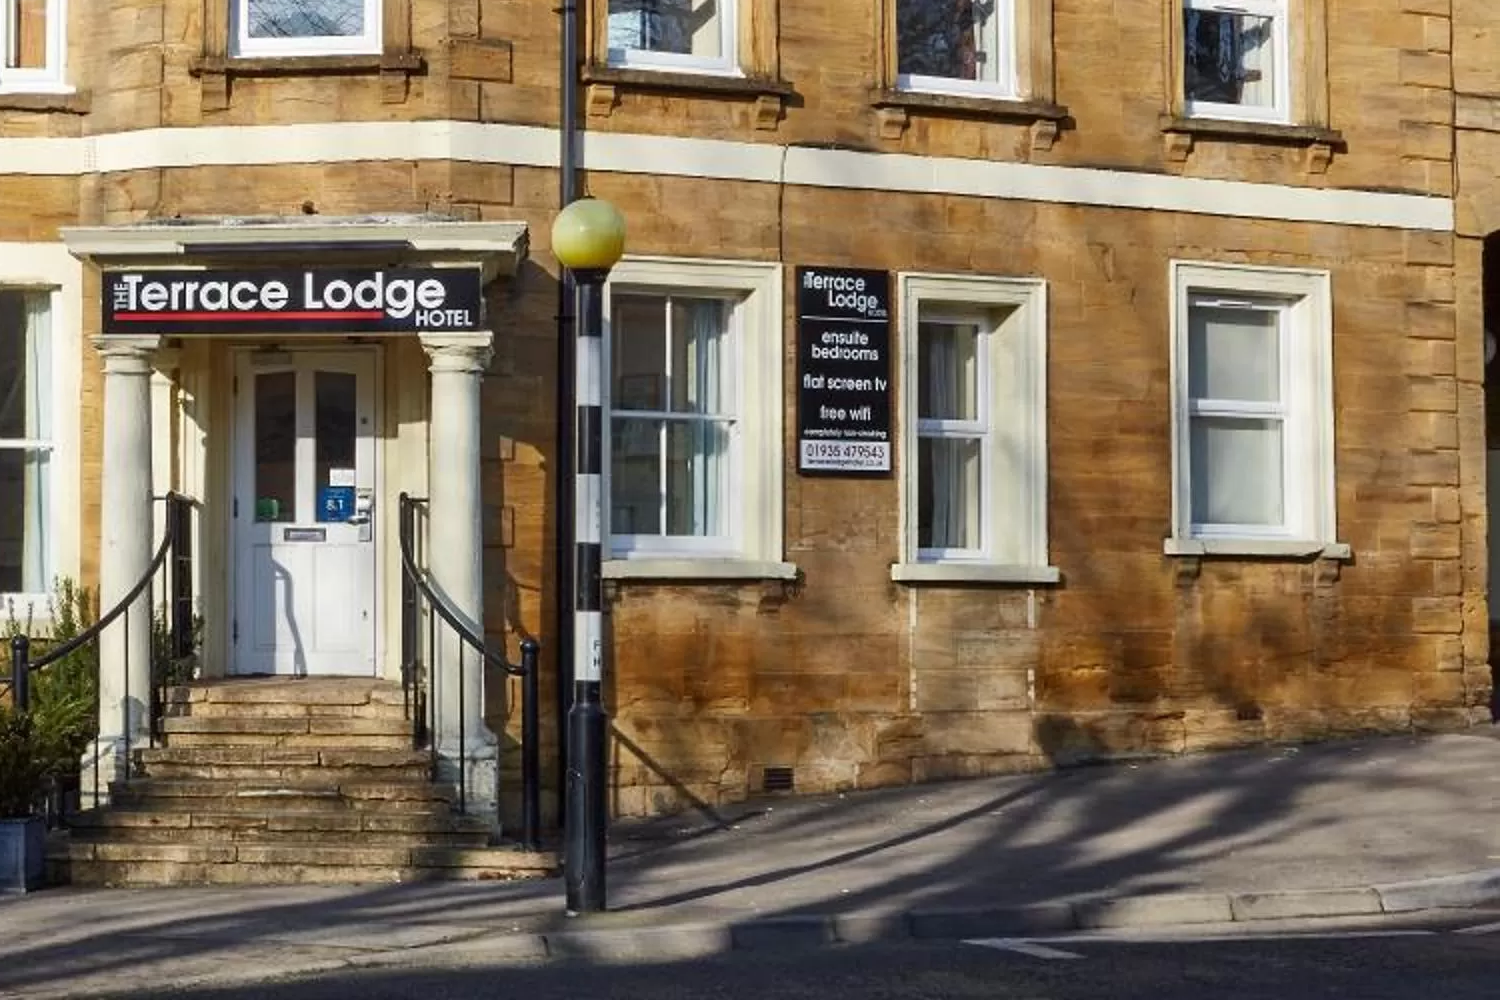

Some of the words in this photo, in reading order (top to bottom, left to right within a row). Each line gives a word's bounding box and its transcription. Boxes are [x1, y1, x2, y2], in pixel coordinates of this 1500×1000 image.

[806, 272, 865, 291] Terrace
[114, 283, 129, 310] THE
[122, 274, 289, 311] Terrace
[304, 272, 447, 318] Lodge
[828, 290, 878, 313] Lodge
[415, 309, 473, 327] HOTEL
[821, 331, 869, 345] ensuite
[811, 343, 879, 361] bedrooms
[803, 373, 825, 389] flat
[827, 377, 873, 391] screen
[875, 376, 887, 391] tv
[819, 404, 846, 420] free
[849, 405, 871, 421] wifi
[806, 443, 841, 457] 01935
